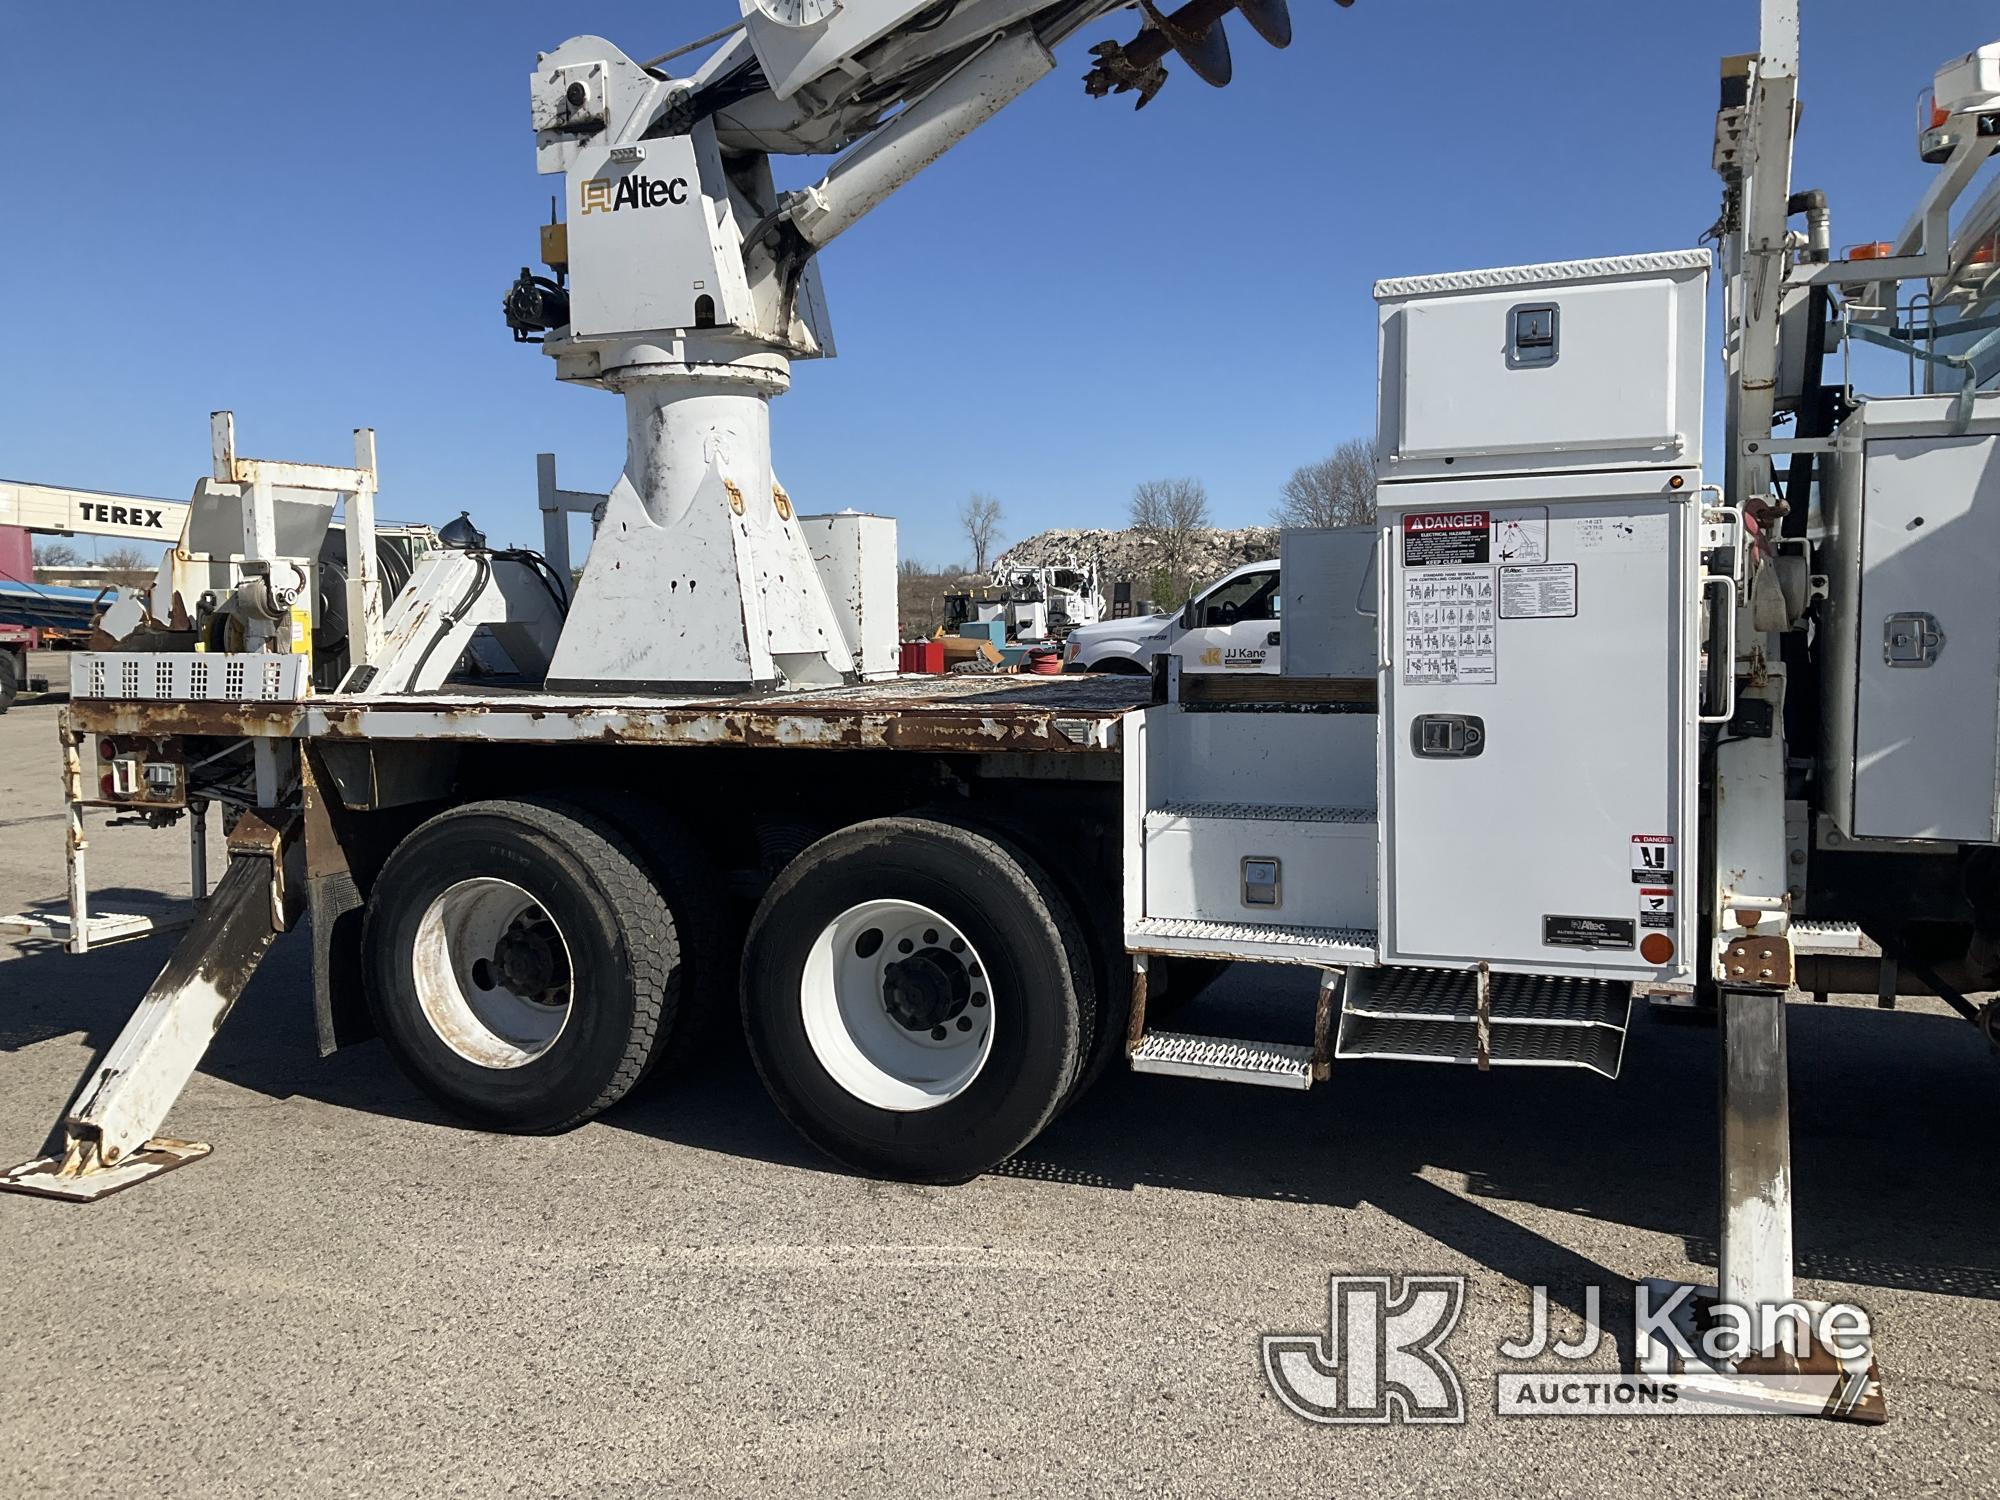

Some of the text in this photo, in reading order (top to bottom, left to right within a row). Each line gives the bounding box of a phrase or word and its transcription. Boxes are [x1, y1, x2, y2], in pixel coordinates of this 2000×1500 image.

[613, 174, 688, 211] Altec
[79, 502, 163, 529] TEREX
[1425, 514, 1482, 529] DANGER
[1225, 648, 1266, 658] JJ Kane
[1581, 920, 1606, 931] Altec
